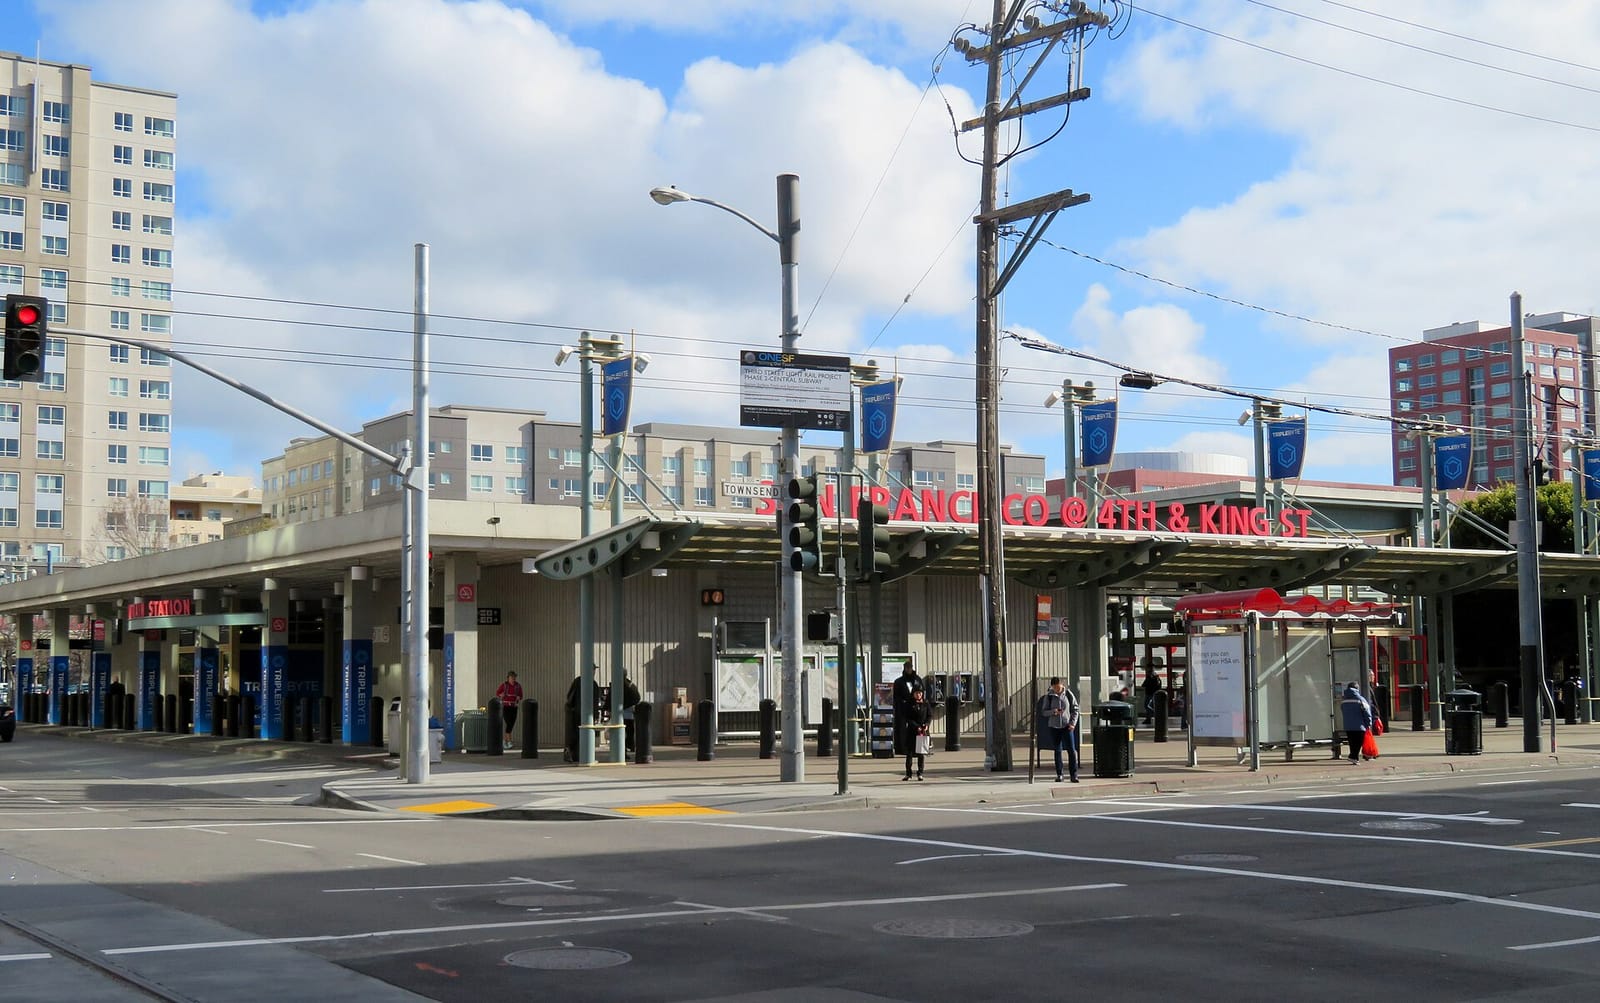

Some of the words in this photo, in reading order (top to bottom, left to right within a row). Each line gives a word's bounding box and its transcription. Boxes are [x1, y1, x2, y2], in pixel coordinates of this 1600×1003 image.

[798, 377, 822, 385] SUBWAY
[817, 373, 842, 381] PROJECT
[724, 484, 780, 497] TOWNSEND
[755, 479, 836, 519] SN
[850, 485, 1050, 528] FRANCICO
[1060, 496, 1088, 529] @
[1098, 499, 1157, 532] 4TH
[1168, 502, 1190, 533] &
[1200, 503, 1270, 537] KING
[1280, 508, 1313, 538] ST
[148, 598, 191, 617] STATION
[274, 668, 282, 726] TRIPLEBYTE
[357, 664, 366, 726] TRIPLEBYTE
